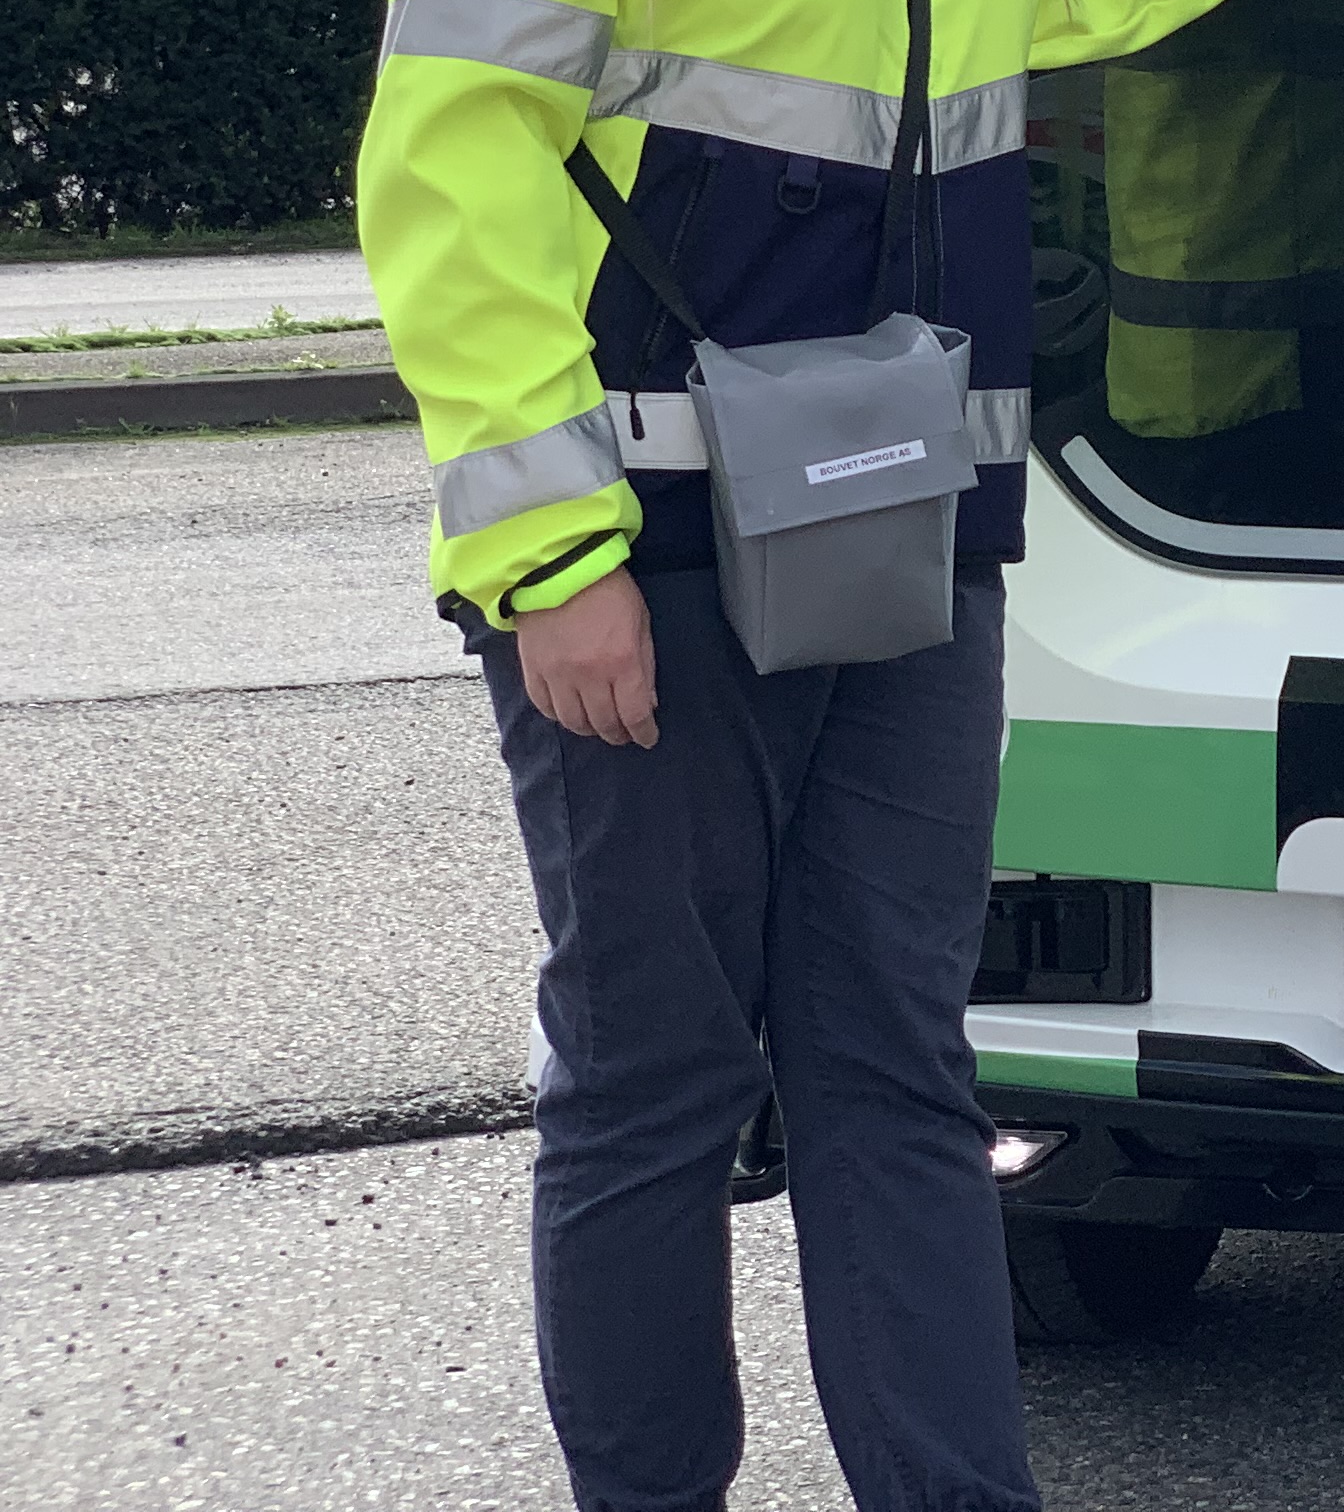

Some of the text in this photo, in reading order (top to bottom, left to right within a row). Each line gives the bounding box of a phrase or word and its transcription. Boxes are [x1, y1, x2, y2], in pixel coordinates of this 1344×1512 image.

[819, 447, 912, 476] BOUVET NORGE AS
